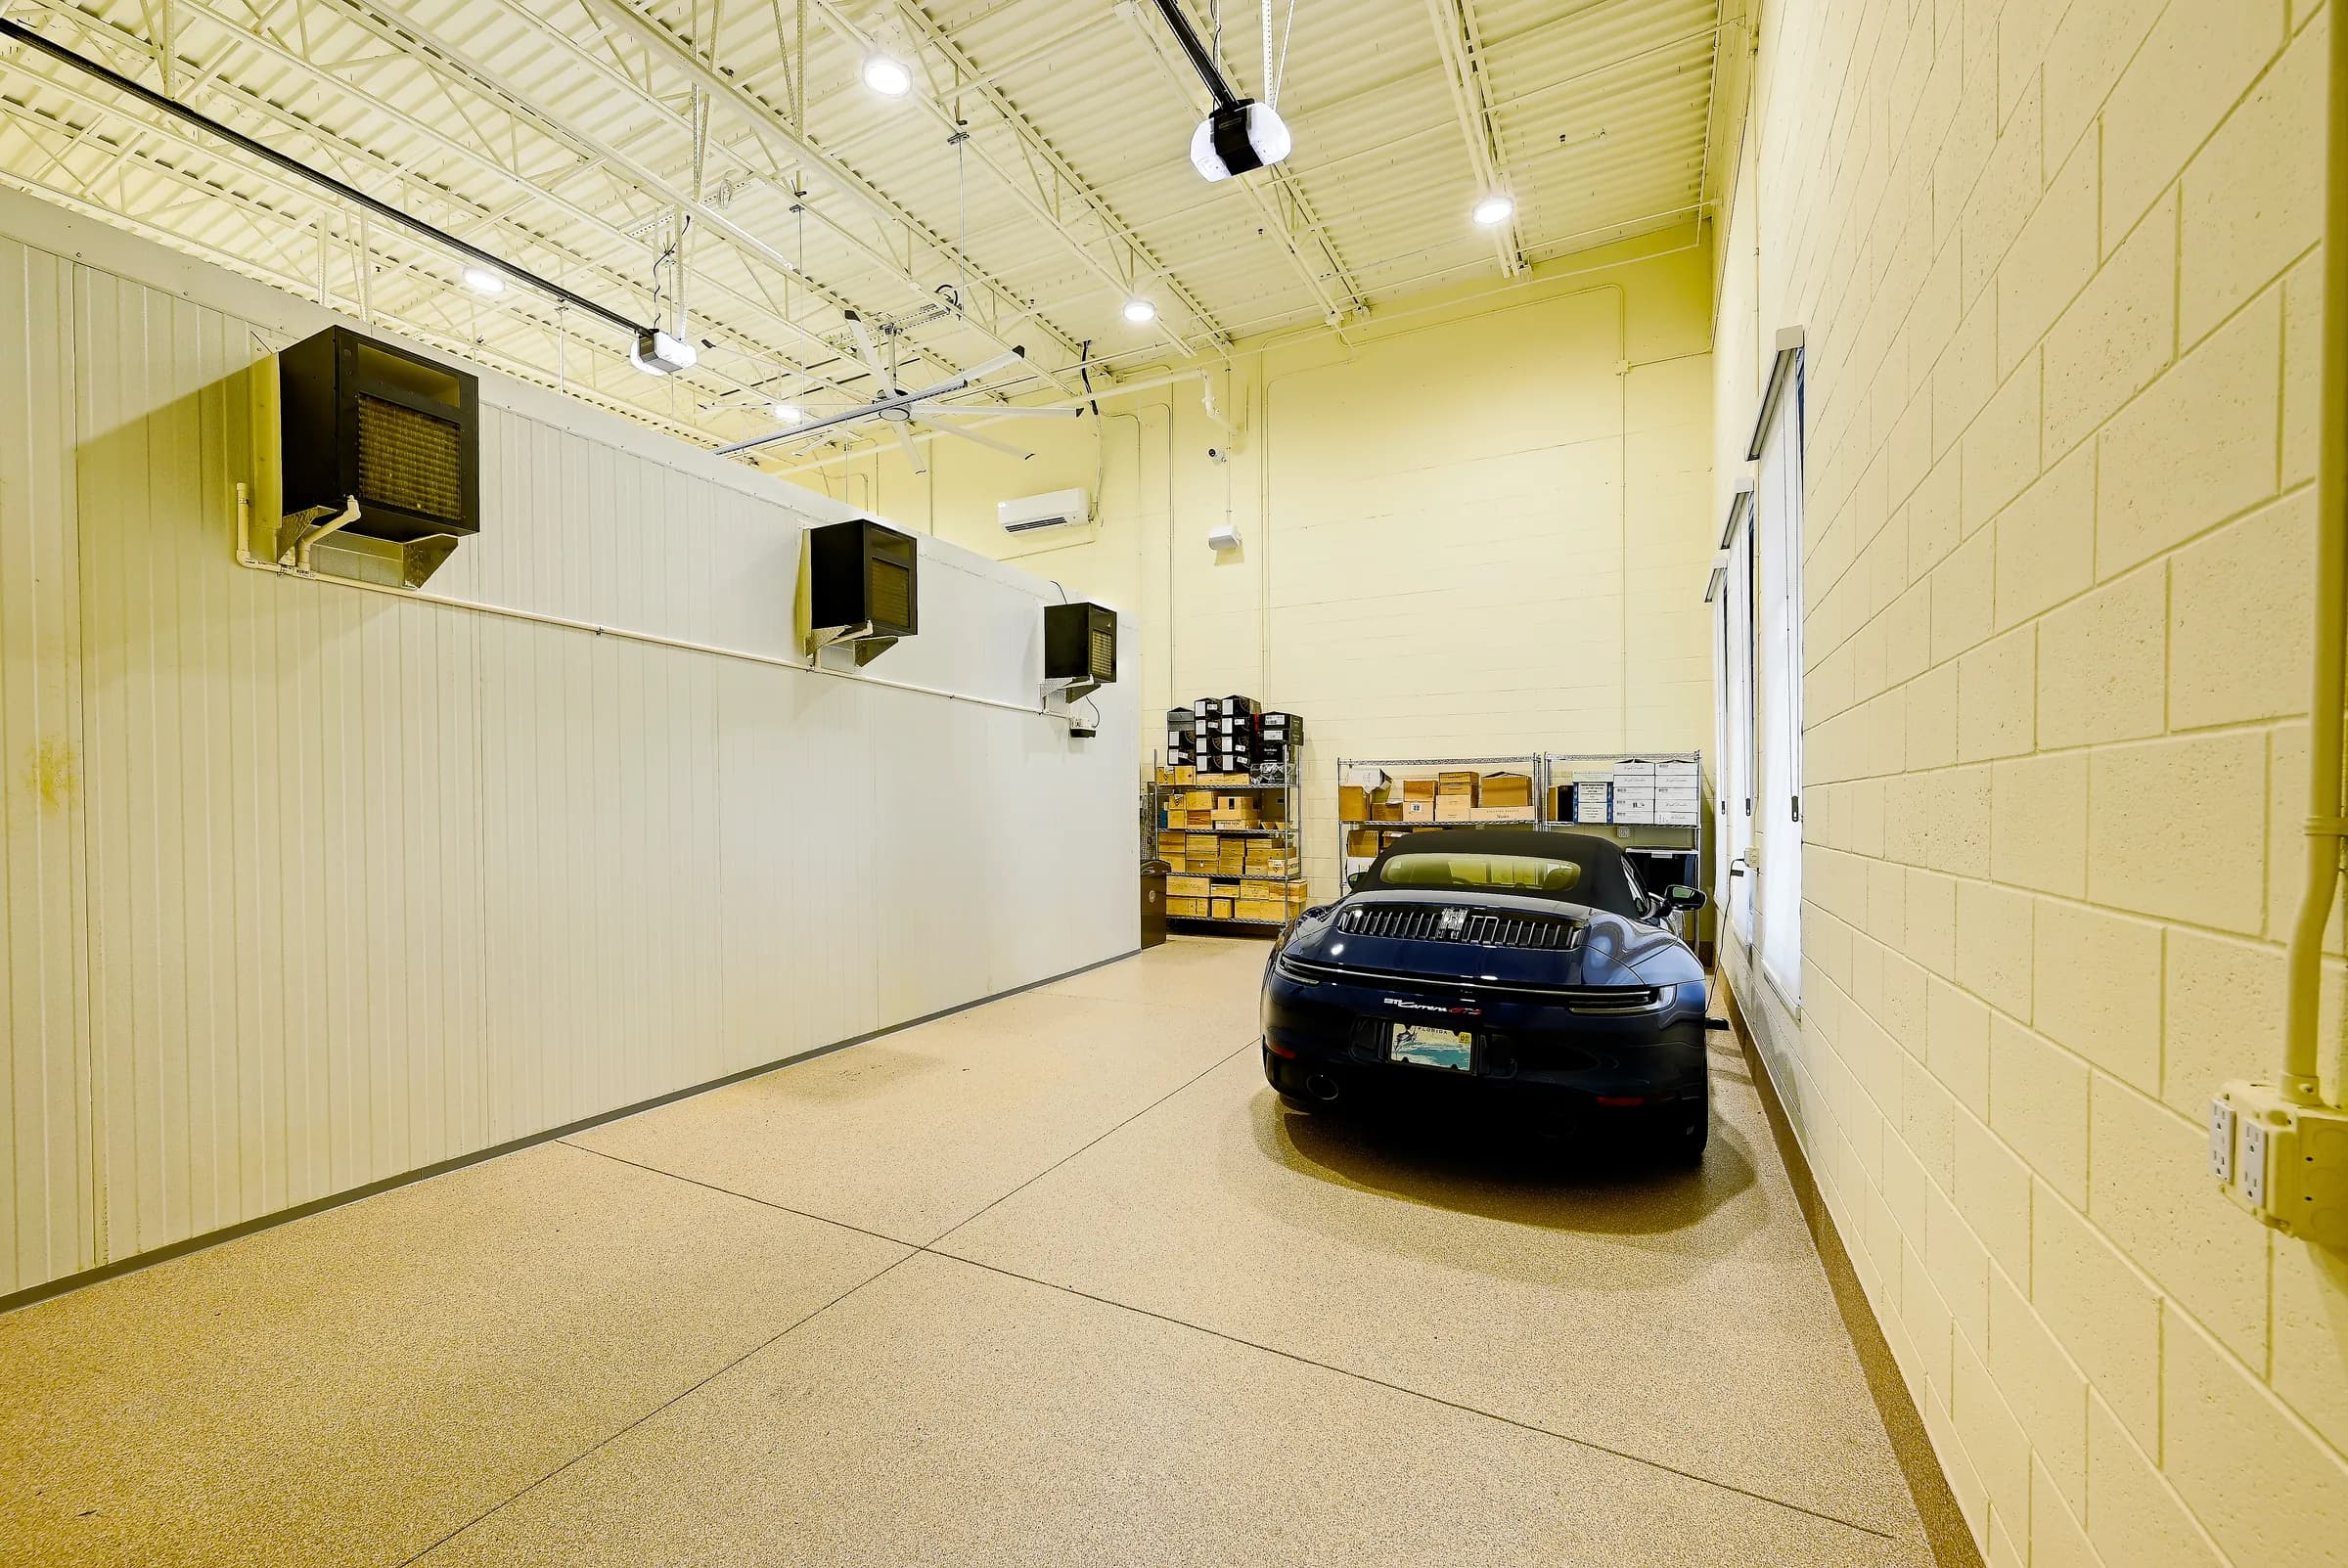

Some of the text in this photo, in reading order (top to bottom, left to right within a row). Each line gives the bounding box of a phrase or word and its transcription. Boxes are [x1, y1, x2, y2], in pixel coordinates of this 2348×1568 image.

[1398, 1002, 1448, 1012] Carrera
[1449, 1007, 1483, 1015] GTS
[1418, 1026, 1448, 1035] FLORIDA
